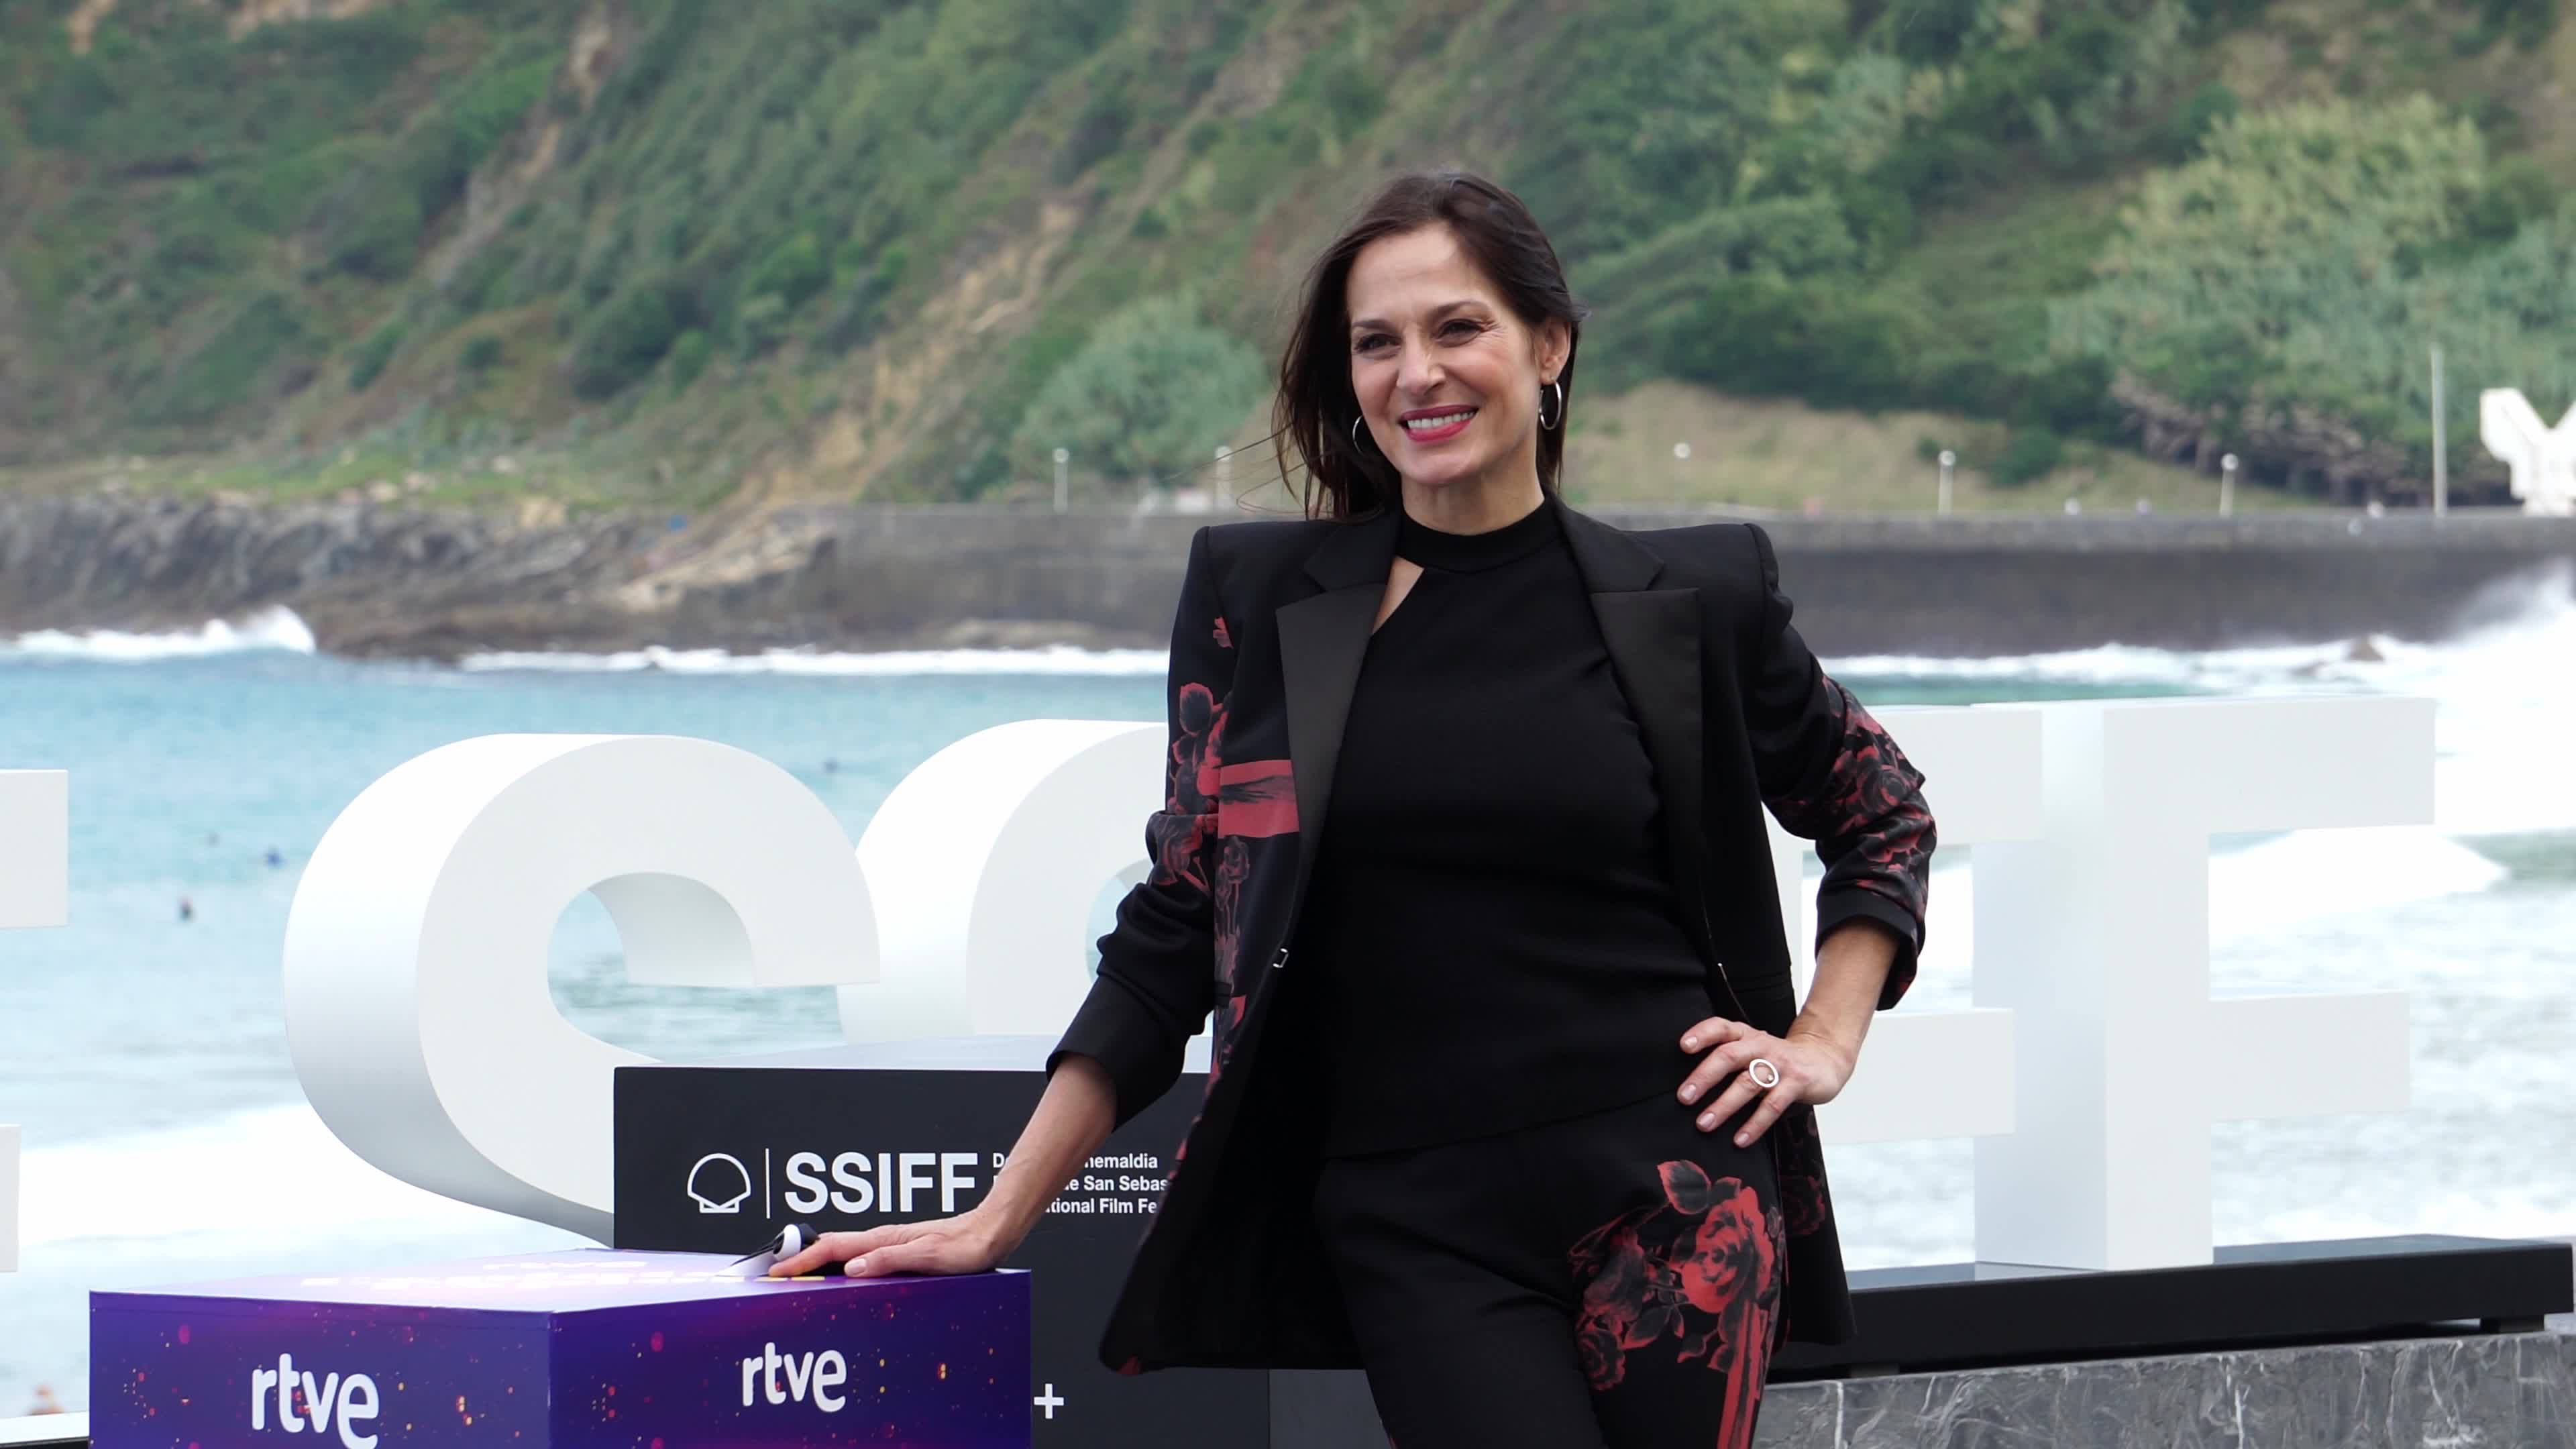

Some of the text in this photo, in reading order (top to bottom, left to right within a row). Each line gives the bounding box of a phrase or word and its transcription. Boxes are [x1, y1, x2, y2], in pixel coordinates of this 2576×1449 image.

[1084, 1152, 1158, 1169] nemaldia
[784, 1151, 979, 1214] SSIFF
[1083, 1175, 1114, 1191] San
[1119, 1175, 1169, 1191] Sebas
[1099, 1197, 1133, 1214] Film
[743, 1342, 847, 1412] rtve
[252, 1352, 380, 1449] rtve
